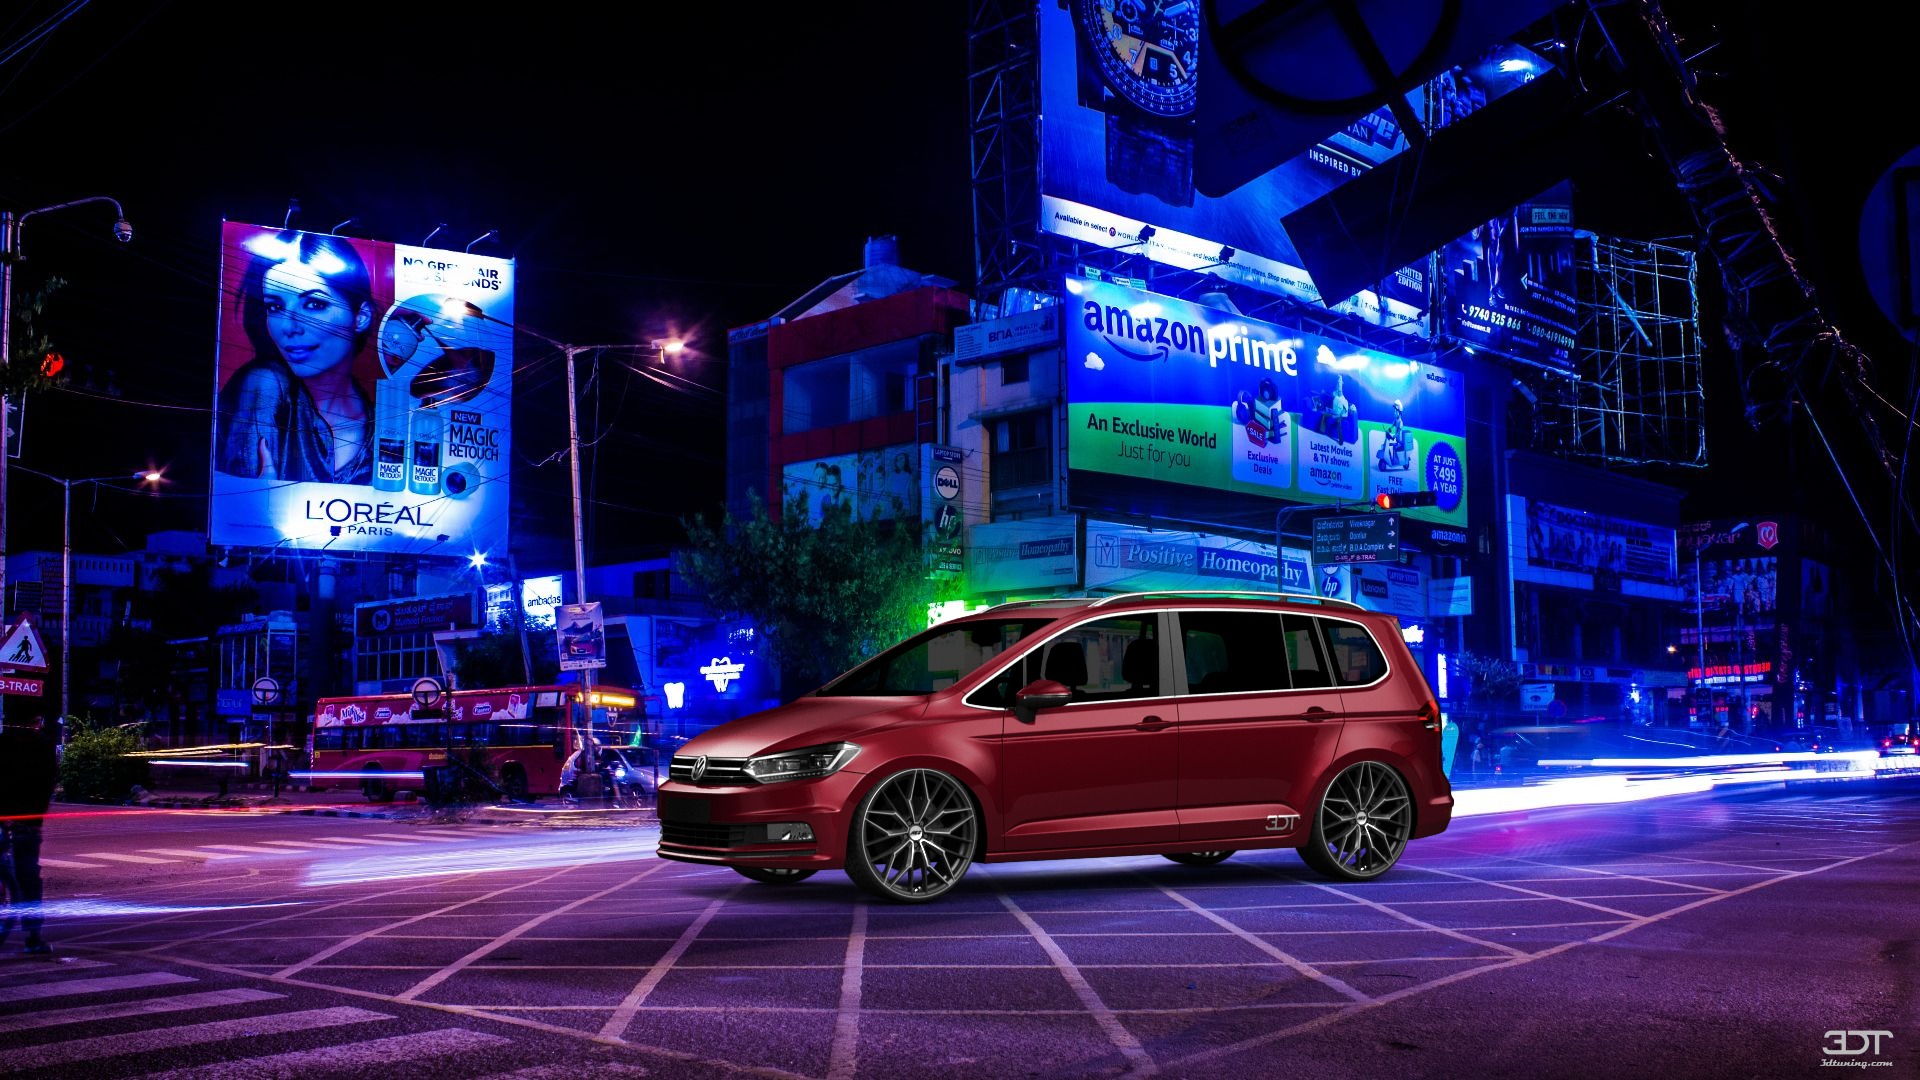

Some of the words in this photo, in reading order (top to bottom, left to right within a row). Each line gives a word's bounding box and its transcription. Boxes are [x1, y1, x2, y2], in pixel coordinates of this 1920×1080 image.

[1183, 51, 1192, 64] 4
[1169, 63, 1178, 78] 5
[1309, 149, 1349, 173] INSPIRED
[1351, 166, 1362, 176] BY
[1055, 212, 1083, 225] Available
[1083, 219, 1090, 227] in
[1090, 223, 1108, 233] select
[1117, 232, 1140, 242] WORLD
[1267, 272, 1280, 283] Shop
[427, 260, 458, 271] GRE
[1397, 275, 1423, 293] EDITION
[1468, 305, 1490, 320] 9740
[1490, 311, 1506, 326] 525
[1506, 317, 1521, 331] 866
[1083, 300, 1206, 355] amazon
[1207, 323, 1298, 377] prime
[454, 412, 478, 423] NEW
[449, 424, 499, 448] MAGIC
[1087, 413, 1108, 431] An
[1112, 416, 1175, 442] Exclusive
[1178, 428, 1217, 449] World
[449, 443, 499, 461] RETOUCH
[1118, 441, 1144, 460] Just
[1148, 443, 1165, 463] for
[1168, 451, 1191, 469] you
[1310, 441, 1330, 453] Latest
[1330, 445, 1353, 457] Movies
[1247, 450, 1279, 464] Exclusive
[1313, 453, 1319, 462] &
[1320, 454, 1329, 464] TV
[1330, 457, 1350, 467] shows
[1433, 454, 1441, 463] AT
[1442, 456, 1456, 467] JUST
[380, 463, 401, 474] MAGIC
[415, 466, 436, 477] MAGIC
[1253, 463, 1273, 475] Deals
[1310, 467, 1342, 481] amazon
[1433, 465, 1456, 483] ₹499
[415, 475, 436, 483] RETOUCH
[938, 477, 958, 489] DELL
[1388, 476, 1403, 486] FREE
[1433, 481, 1438, 491] A
[1440, 482, 1457, 495] YEAR
[306, 499, 434, 527] L'ORÉAL
[347, 525, 393, 537] PARIS
[1127, 544, 1193, 567] Positive
[1201, 550, 1303, 586] Homeopahy
[1324, 576, 1338, 598] hp
[527, 595, 561, 608] ambadas
[0, 681, 38, 693] B-TRAC
[1265, 814, 1300, 831] 3DT
